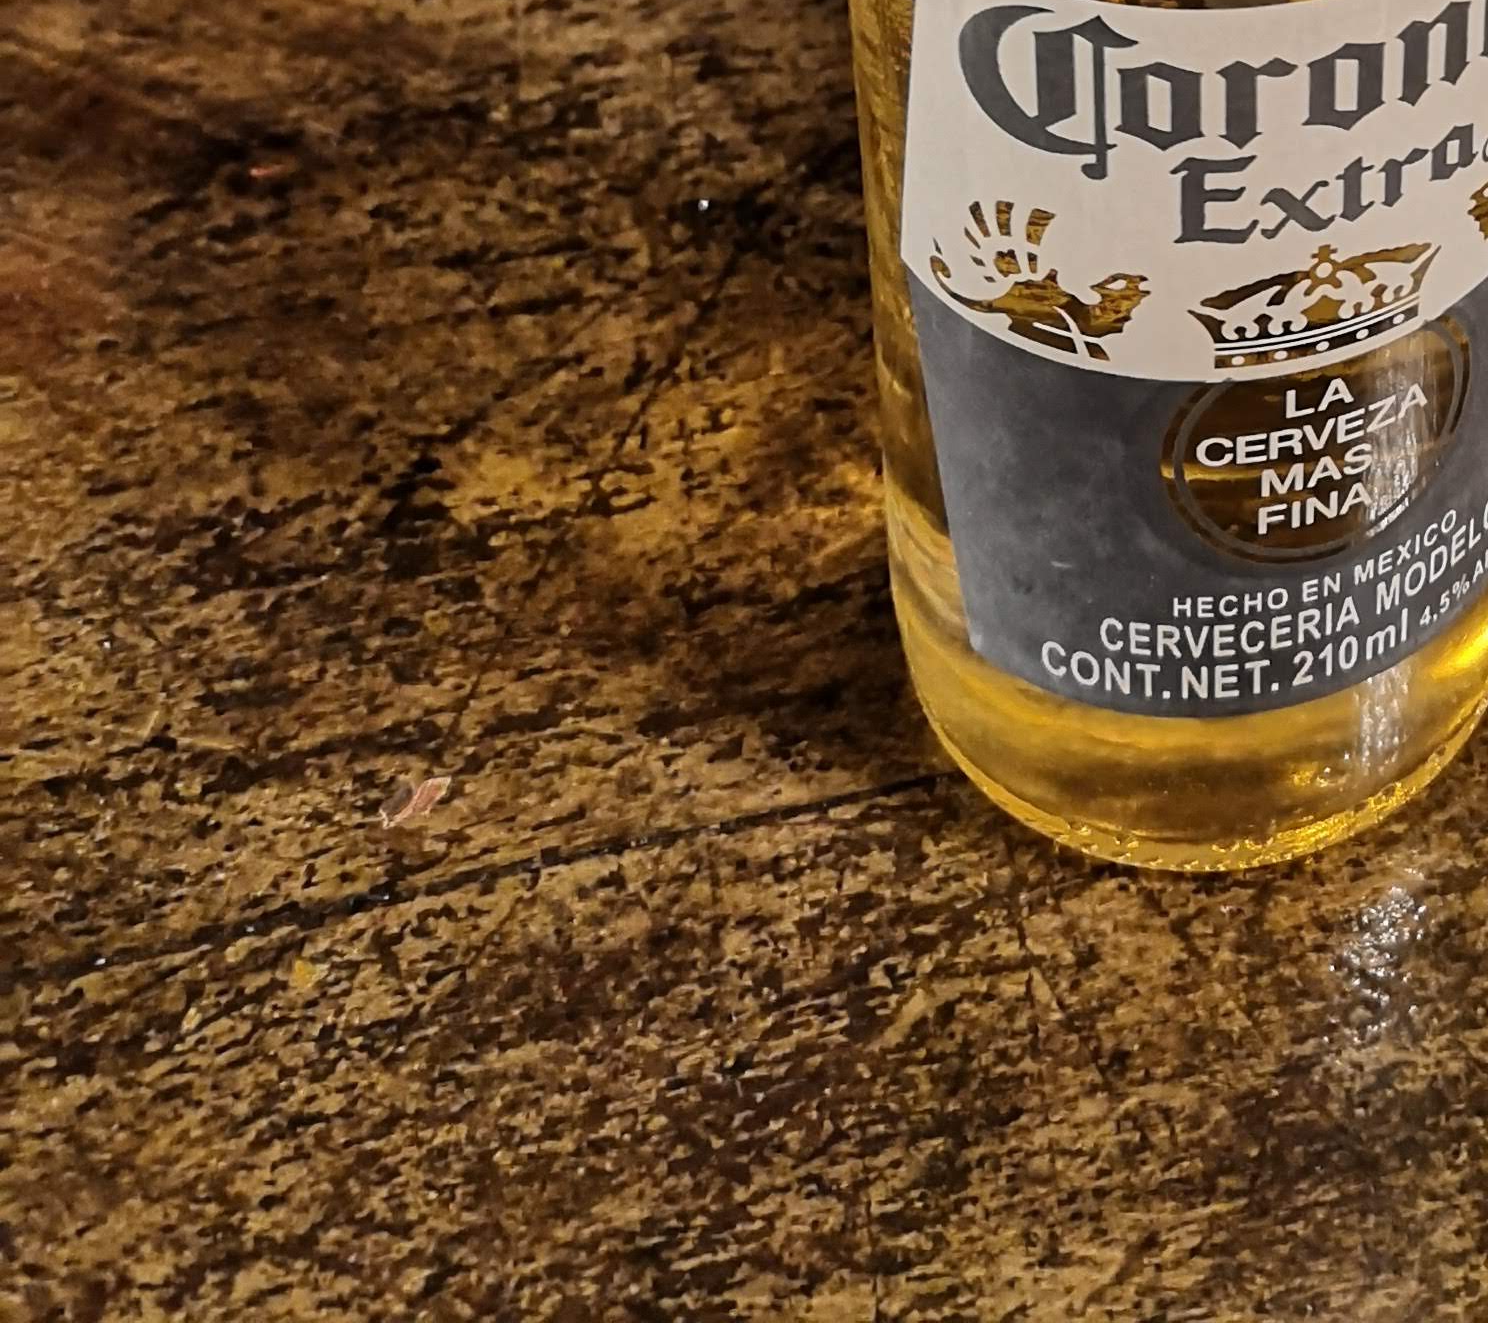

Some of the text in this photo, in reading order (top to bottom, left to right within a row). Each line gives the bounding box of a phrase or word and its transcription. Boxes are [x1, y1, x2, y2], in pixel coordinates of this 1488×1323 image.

[1195, 382, 1429, 468] CERVEZA
[1284, 376, 1355, 419] LA
[1259, 442, 1373, 498] MAS
[1256, 481, 1374, 536] FINA
[1172, 509, 1458, 618] HECHO EN MEXICO
[1099, 595, 1361, 659] CERVECERIA
